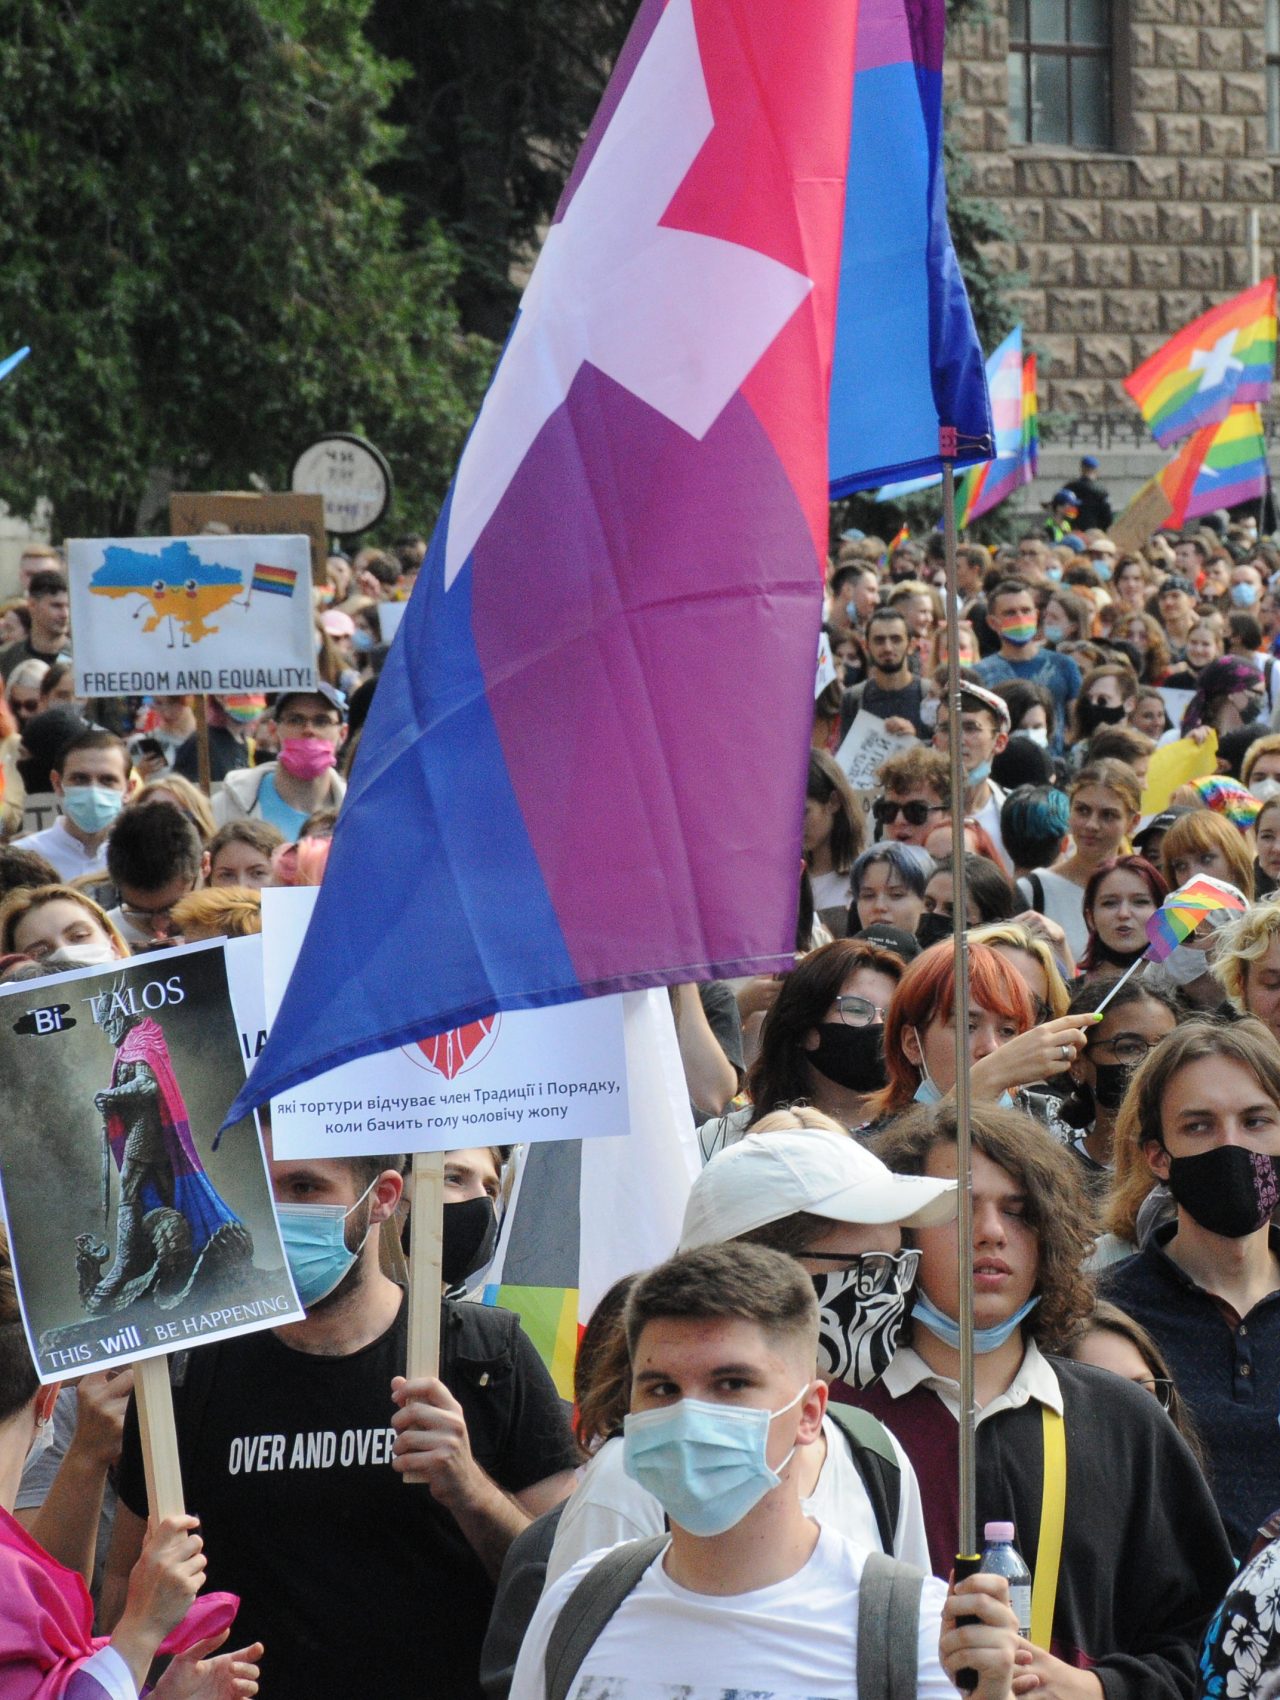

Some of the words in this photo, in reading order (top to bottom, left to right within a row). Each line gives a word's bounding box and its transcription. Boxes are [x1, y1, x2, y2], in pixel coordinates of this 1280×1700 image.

[83, 672, 169, 692] FREEDOM
[176, 670, 212, 690] AND
[219, 668, 311, 688] EQUALITY!
[81, 976, 185, 1024] TALOS
[34, 1007, 63, 1034] Bi
[277, 1100, 296, 1114] які
[299, 1099, 363, 1116] тортури
[367, 1095, 435, 1112] відчуває
[439, 1091, 471, 1104] член
[474, 1083, 535, 1105] Традиції
[547, 1080, 621, 1098] Порядку,
[325, 1121, 362, 1134] коли
[367, 1117, 423, 1131] бачить
[427, 1115, 459, 1130] голу
[462, 1107, 524, 1125] чоловічу
[528, 1105, 569, 1120] жопу
[46, 1344, 92, 1369] THIS
[99, 1325, 142, 1354] will
[154, 1319, 181, 1342] BE
[183, 1294, 290, 1336] HAPPENING
[228, 1434, 287, 1476] OVER
[289, 1431, 337, 1470] AND
